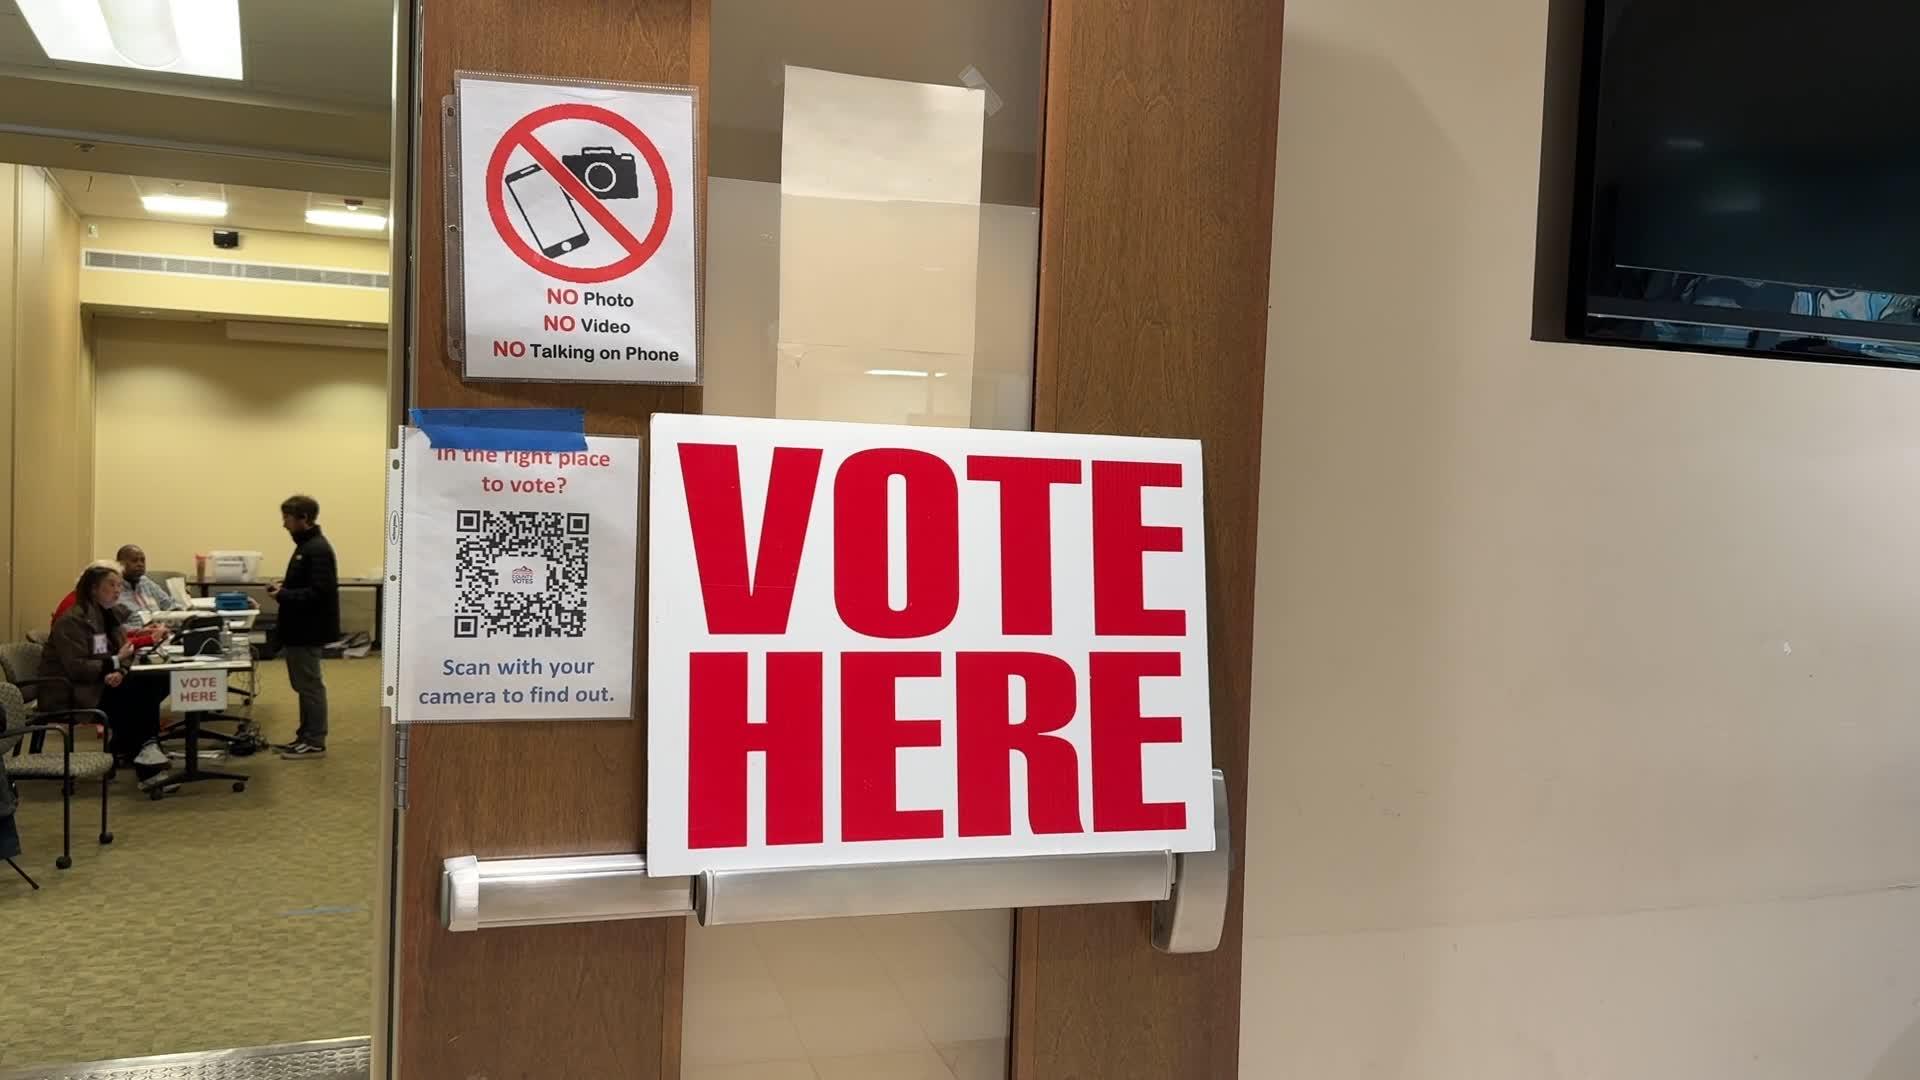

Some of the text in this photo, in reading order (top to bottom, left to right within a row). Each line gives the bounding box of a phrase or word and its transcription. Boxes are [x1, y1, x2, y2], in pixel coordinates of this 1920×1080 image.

[546, 288, 635, 308] NO Photo
[543, 314, 631, 334] NO Video
[492, 340, 679, 363] NO Talking on Phone
[462, 449, 498, 463] the
[503, 449, 553, 468] right
[558, 451, 611, 469] place
[482, 477, 567, 494] to vote?
[677, 443, 1187, 639] VOTE
[442, 658, 595, 679] Scan with your
[180, 677, 217, 688] VOTE
[180, 691, 217, 702] HERE
[418, 686, 615, 705] camera to find out.
[687, 651, 1188, 850] HERE
